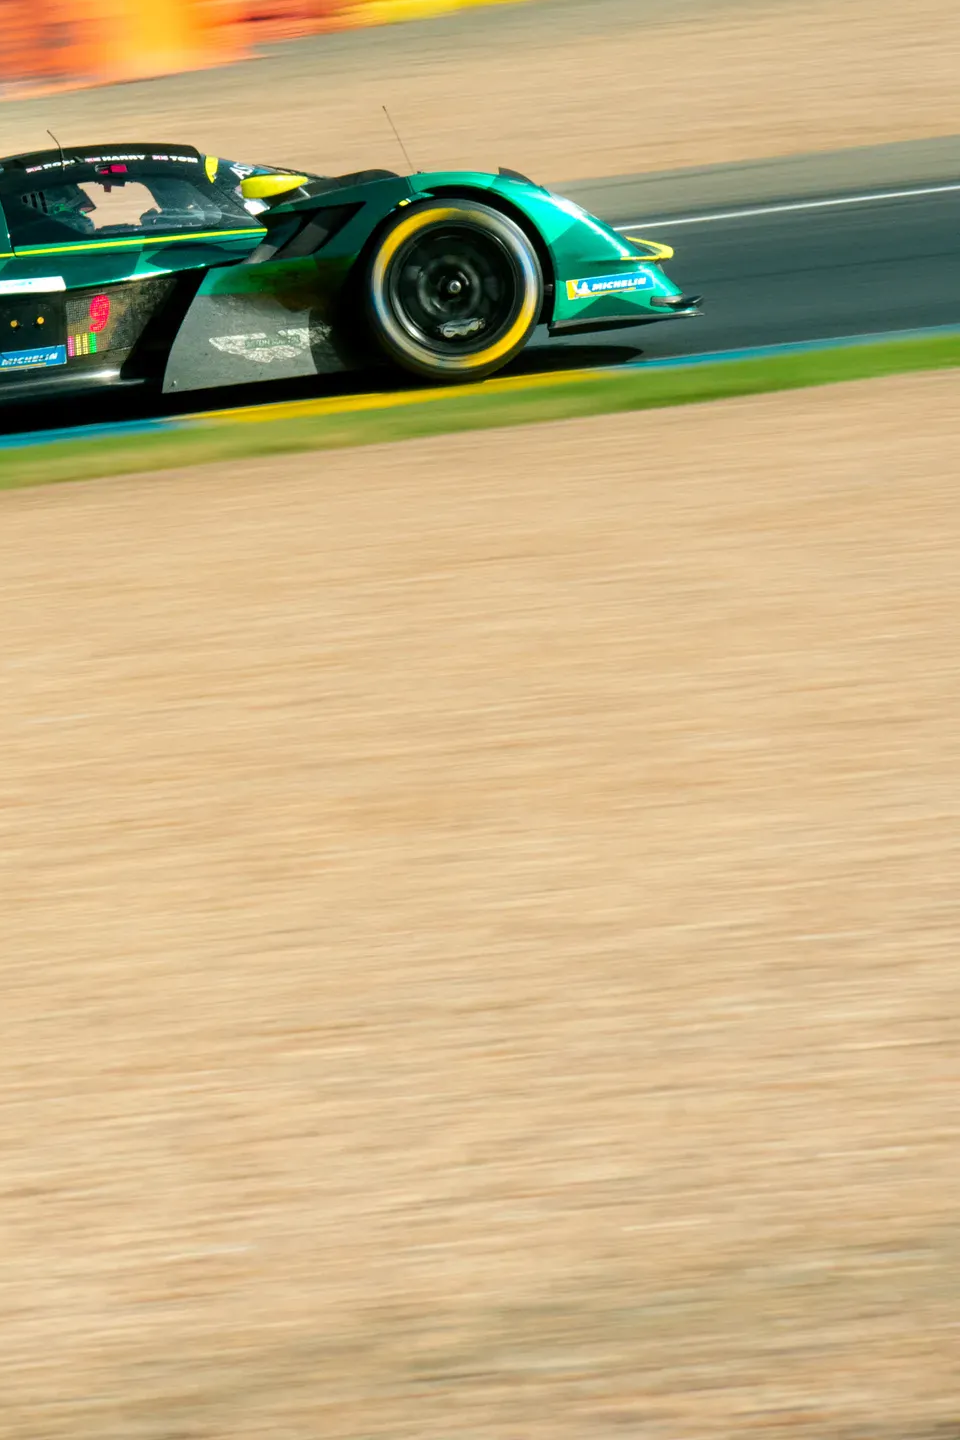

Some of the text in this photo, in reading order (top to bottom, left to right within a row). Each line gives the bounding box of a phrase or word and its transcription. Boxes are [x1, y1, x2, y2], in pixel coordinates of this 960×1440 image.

[169, 155, 199, 164] TOM
[591, 277, 647, 291] MICHELIN
[89, 294, 111, 333] 9
[1, 352, 59, 366] MICHELIN
